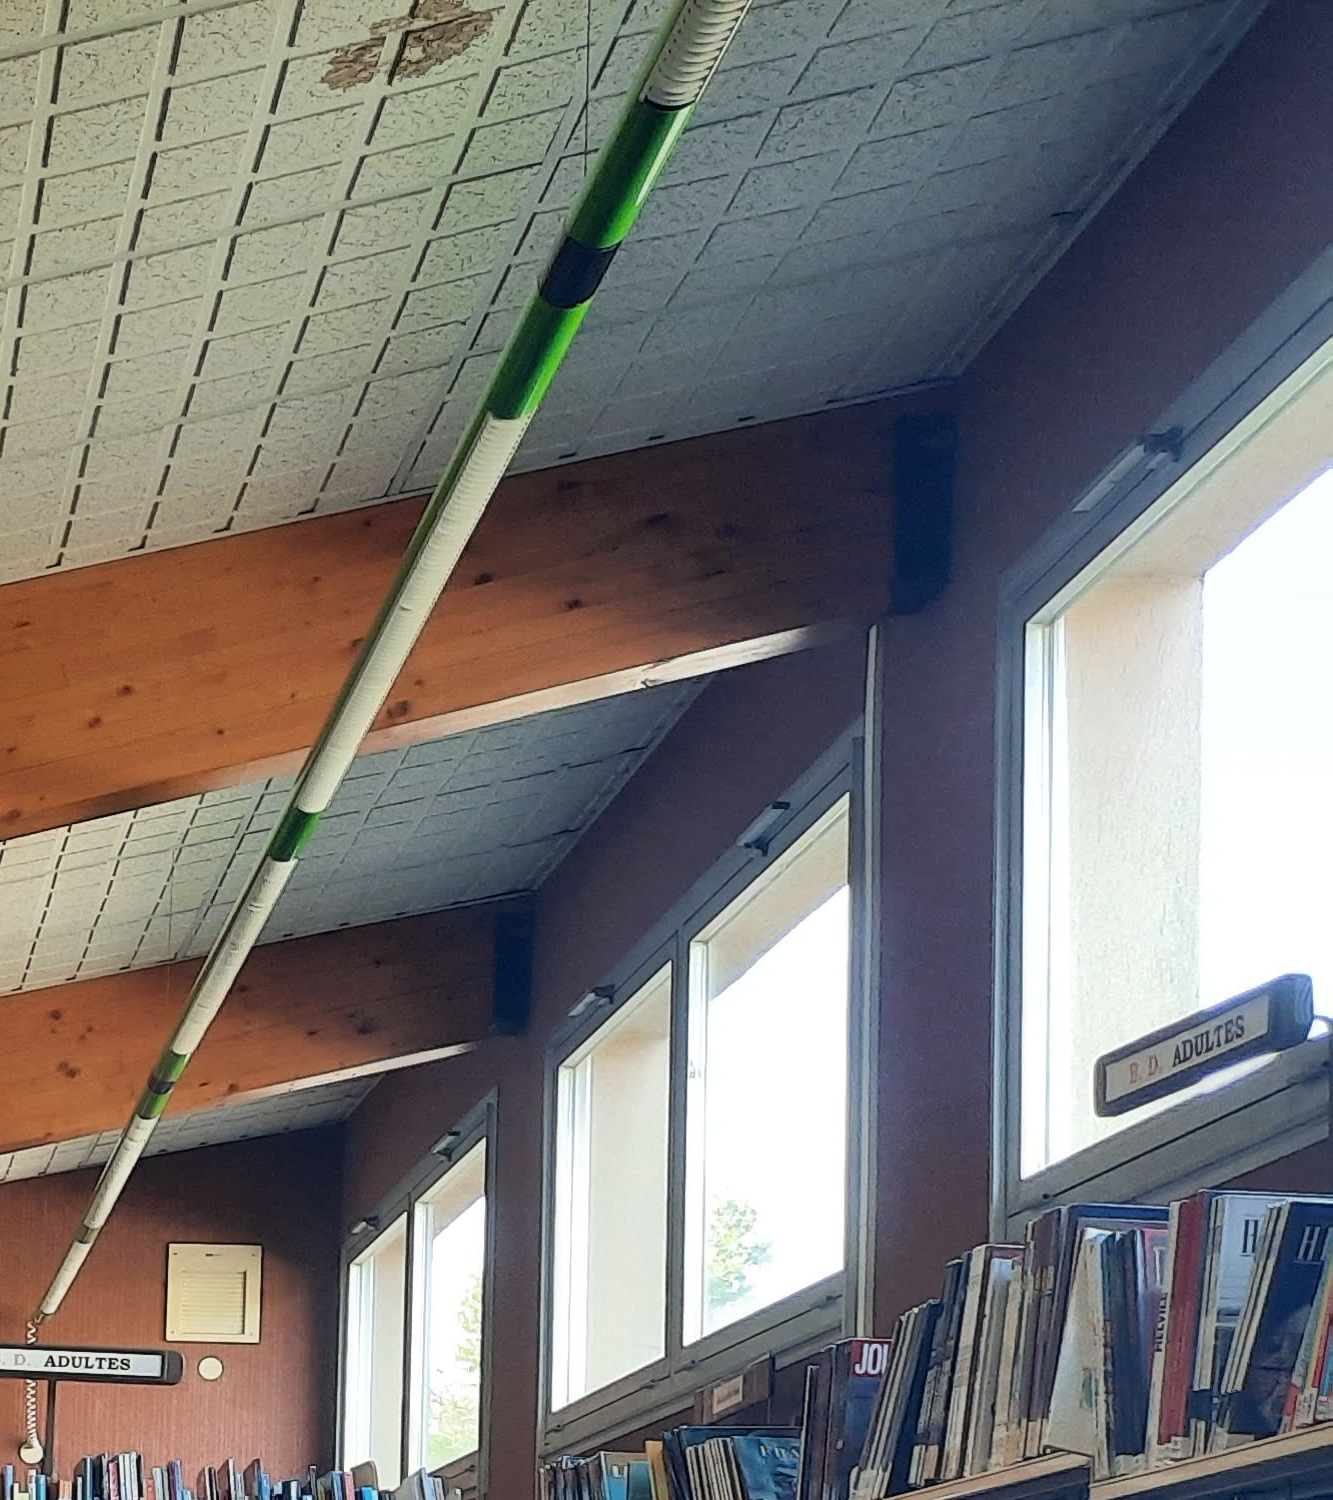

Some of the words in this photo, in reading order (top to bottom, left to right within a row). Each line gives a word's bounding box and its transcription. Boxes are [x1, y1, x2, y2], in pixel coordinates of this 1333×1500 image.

[1171, 1014, 1245, 1068] ADULTES
[14, 1354, 31, 1367] D.
[43, 1355, 131, 1371] ADULTES
